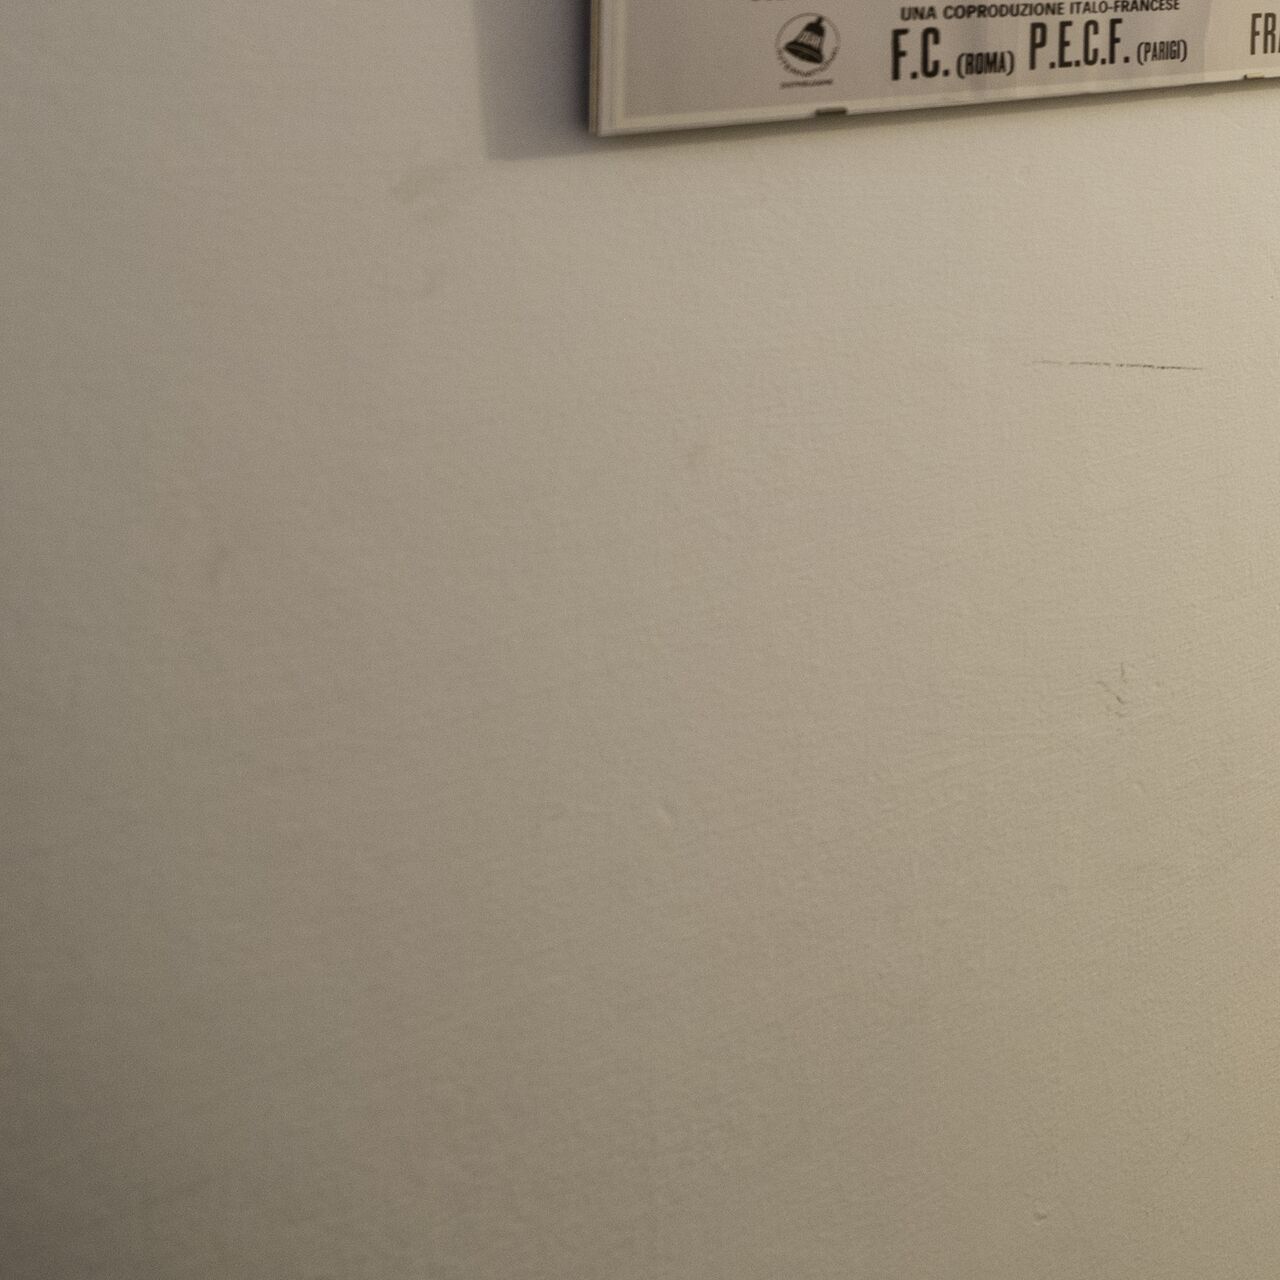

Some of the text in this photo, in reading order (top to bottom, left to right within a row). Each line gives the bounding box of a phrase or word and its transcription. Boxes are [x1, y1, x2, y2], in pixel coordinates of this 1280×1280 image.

[900, 6, 937, 22] UNA
[942, 2, 1065, 20] COPRODUZIONE
[890, 19, 1189, 81] F.C. (ROMA) P.E.C.F. (PARIGI)
